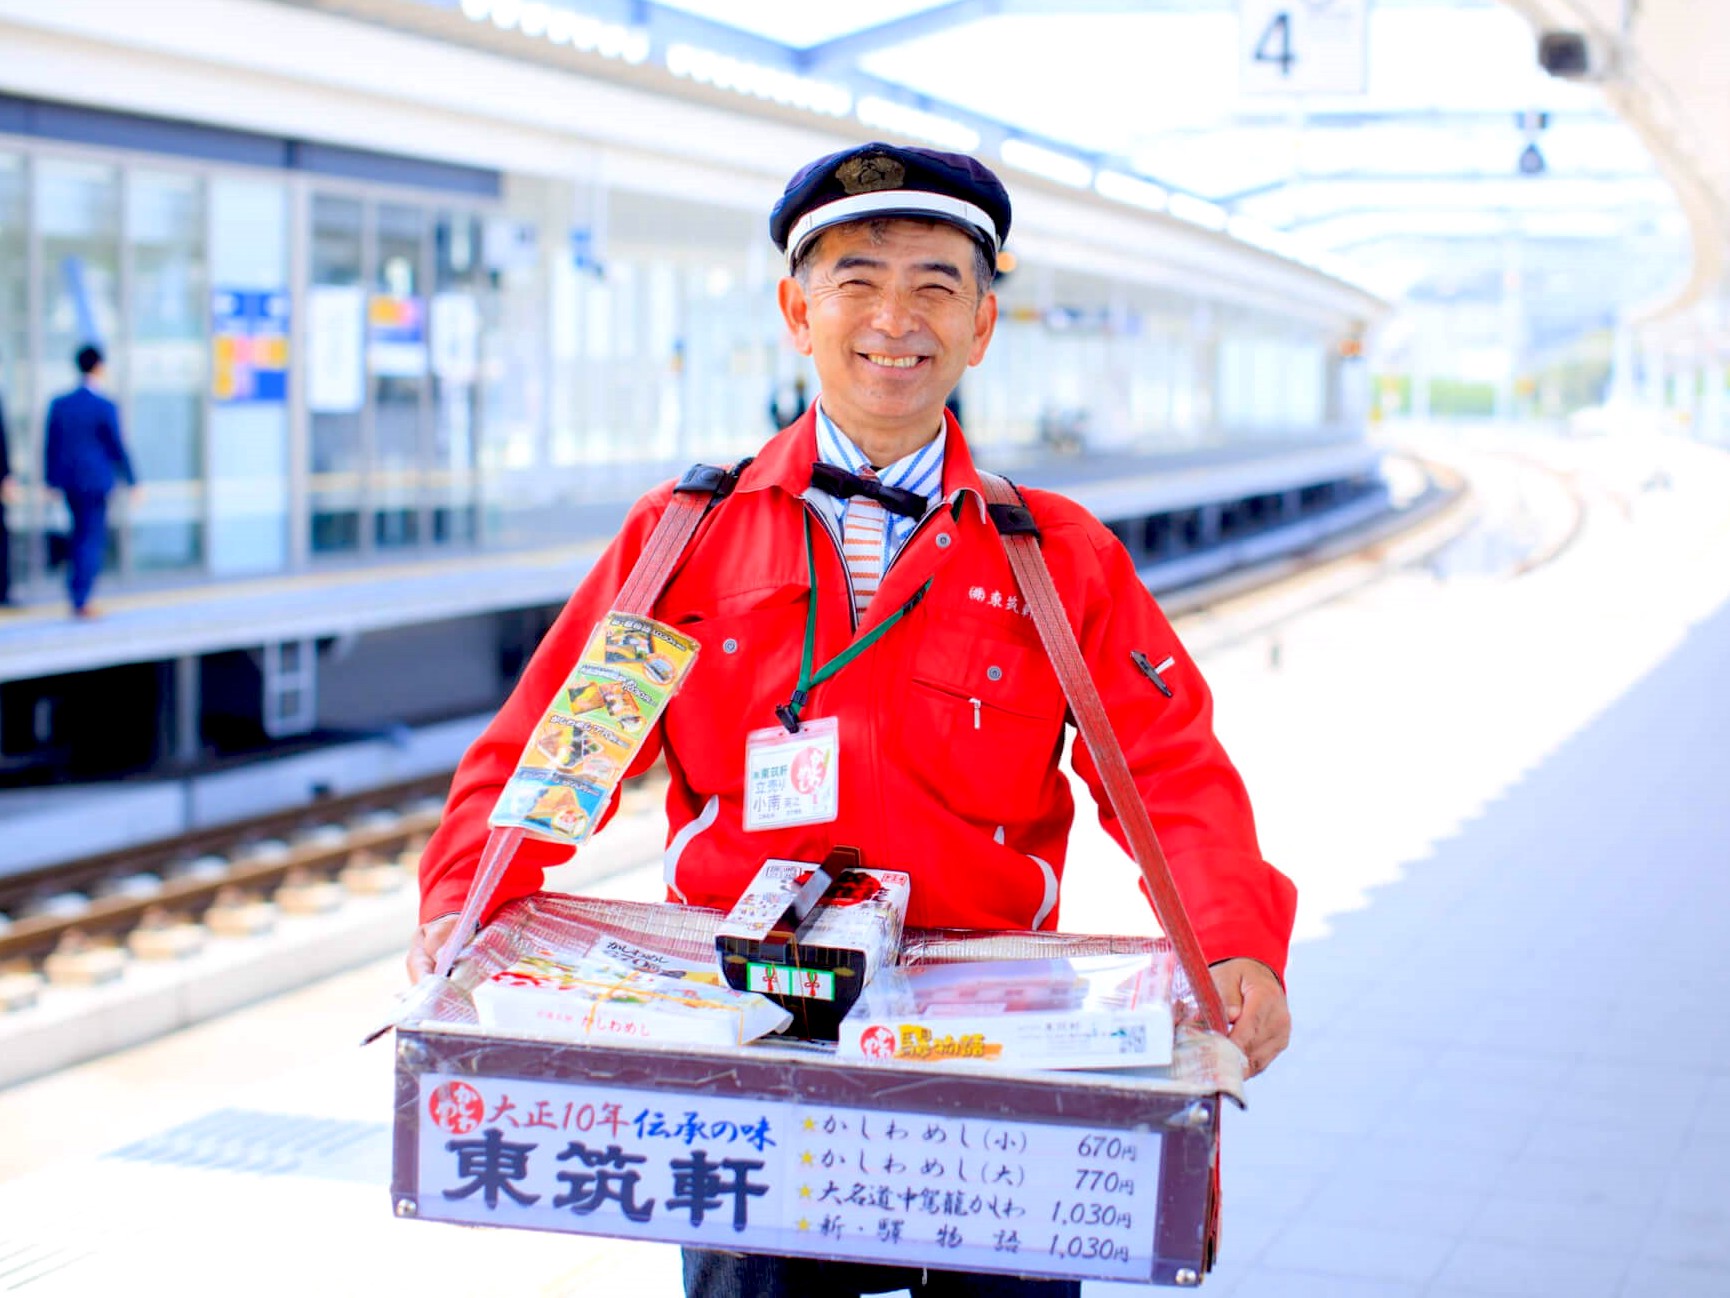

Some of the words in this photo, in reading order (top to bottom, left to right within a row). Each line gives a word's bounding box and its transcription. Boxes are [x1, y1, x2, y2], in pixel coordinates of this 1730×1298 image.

[1253, 12, 1297, 77] 4
[487, 1094, 630, 1139] 大正10年
[633, 1107, 777, 1152] 伝承の味
[1078, 1133, 1136, 1162] 670円
[442, 1128, 770, 1232] 東筑軒
[1075, 1167, 1134, 1196] 770円
